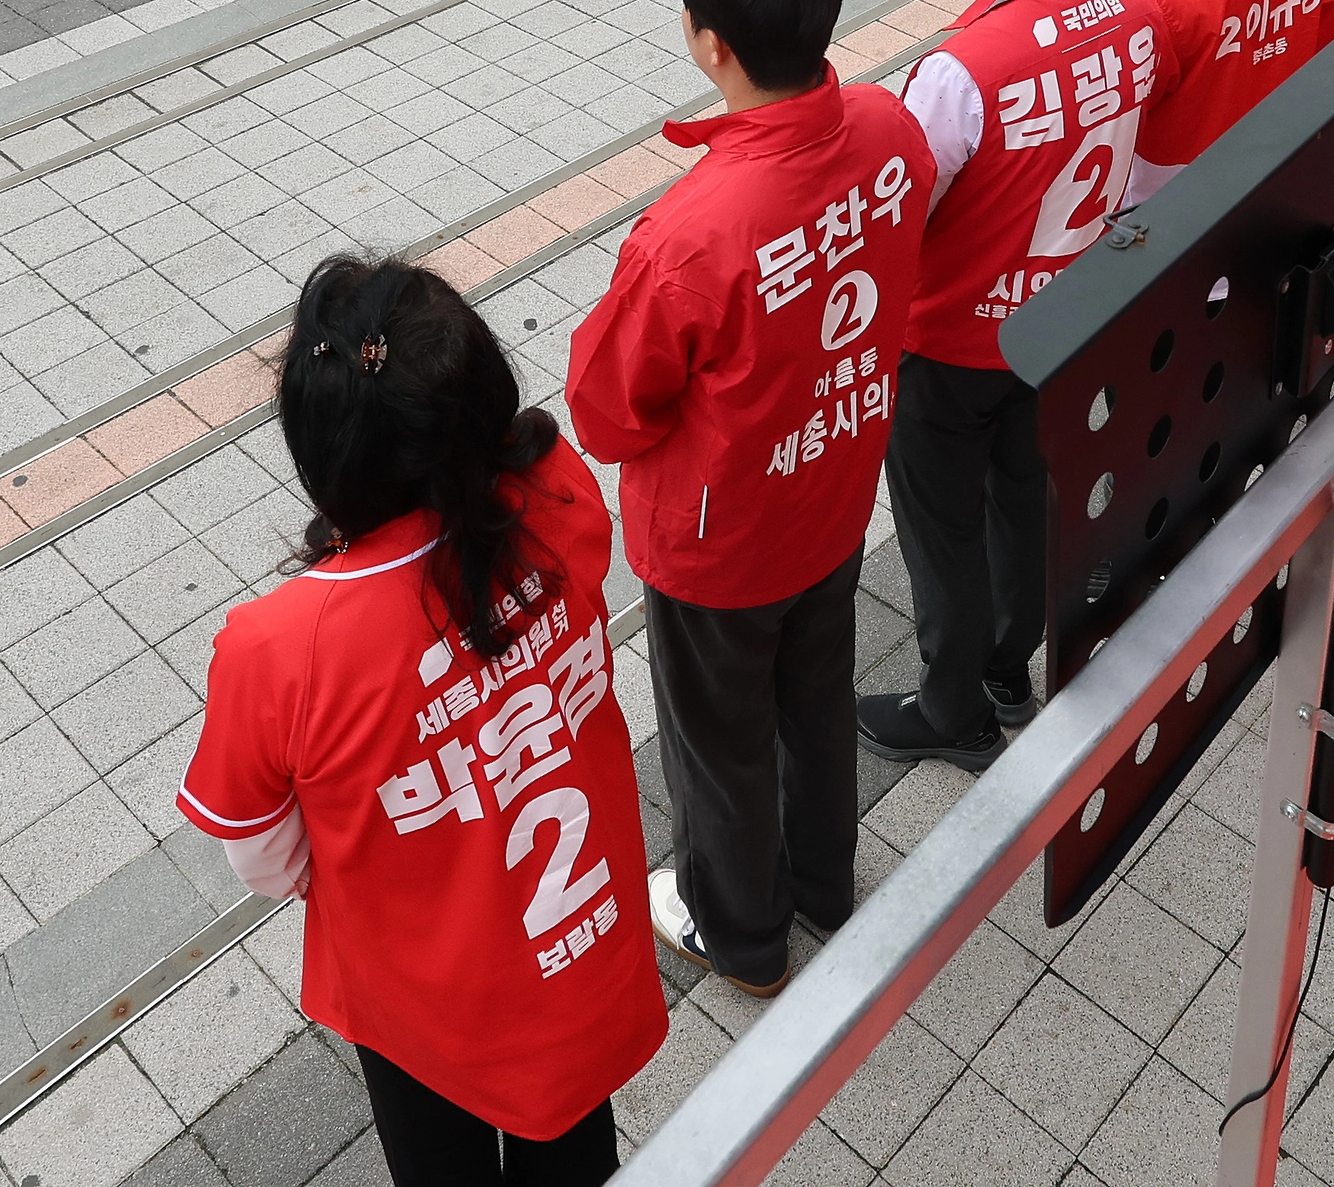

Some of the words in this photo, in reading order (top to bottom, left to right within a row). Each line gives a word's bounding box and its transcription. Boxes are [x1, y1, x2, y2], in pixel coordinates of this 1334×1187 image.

[999, 25, 1162, 151] 김광운
[1215, 16, 1241, 60] 2
[756, 156, 912, 315] 문찬우
[814, 347, 878, 400] 아름동
[376, 616, 609, 836] 박윤경
[416, 618, 553, 743] 세종시의원
[505, 787, 610, 941] 2
[536, 894, 619, 980] 보람동
